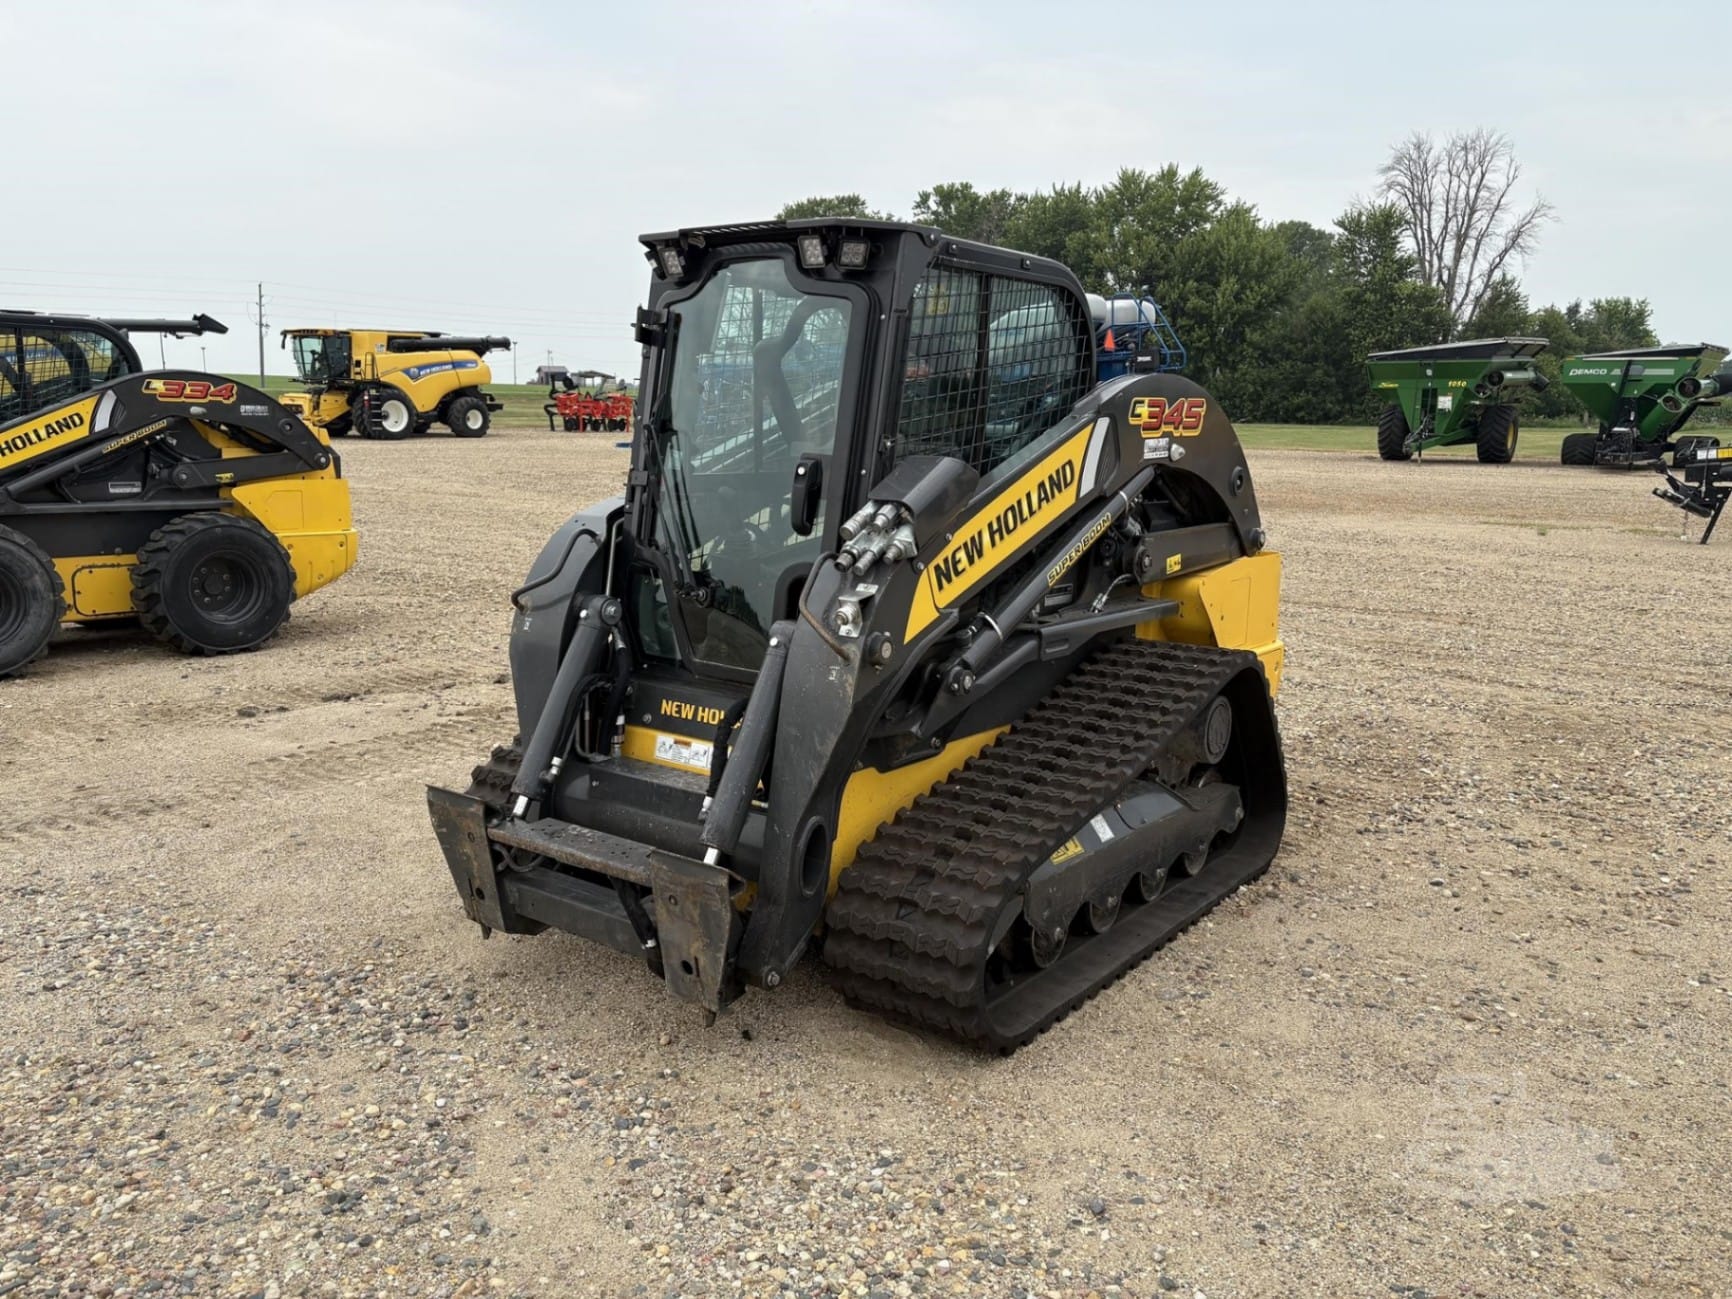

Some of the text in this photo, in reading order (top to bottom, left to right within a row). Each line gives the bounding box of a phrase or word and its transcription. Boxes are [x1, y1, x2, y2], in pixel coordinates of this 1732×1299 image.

[1568, 368, 1608, 376] DEMCO
[0, 411, 85, 457] HOLLAND
[1128, 397, 1207, 438] C345
[933, 458, 1075, 593] NEW HOLLAND
[660, 698, 695, 720] NEW
